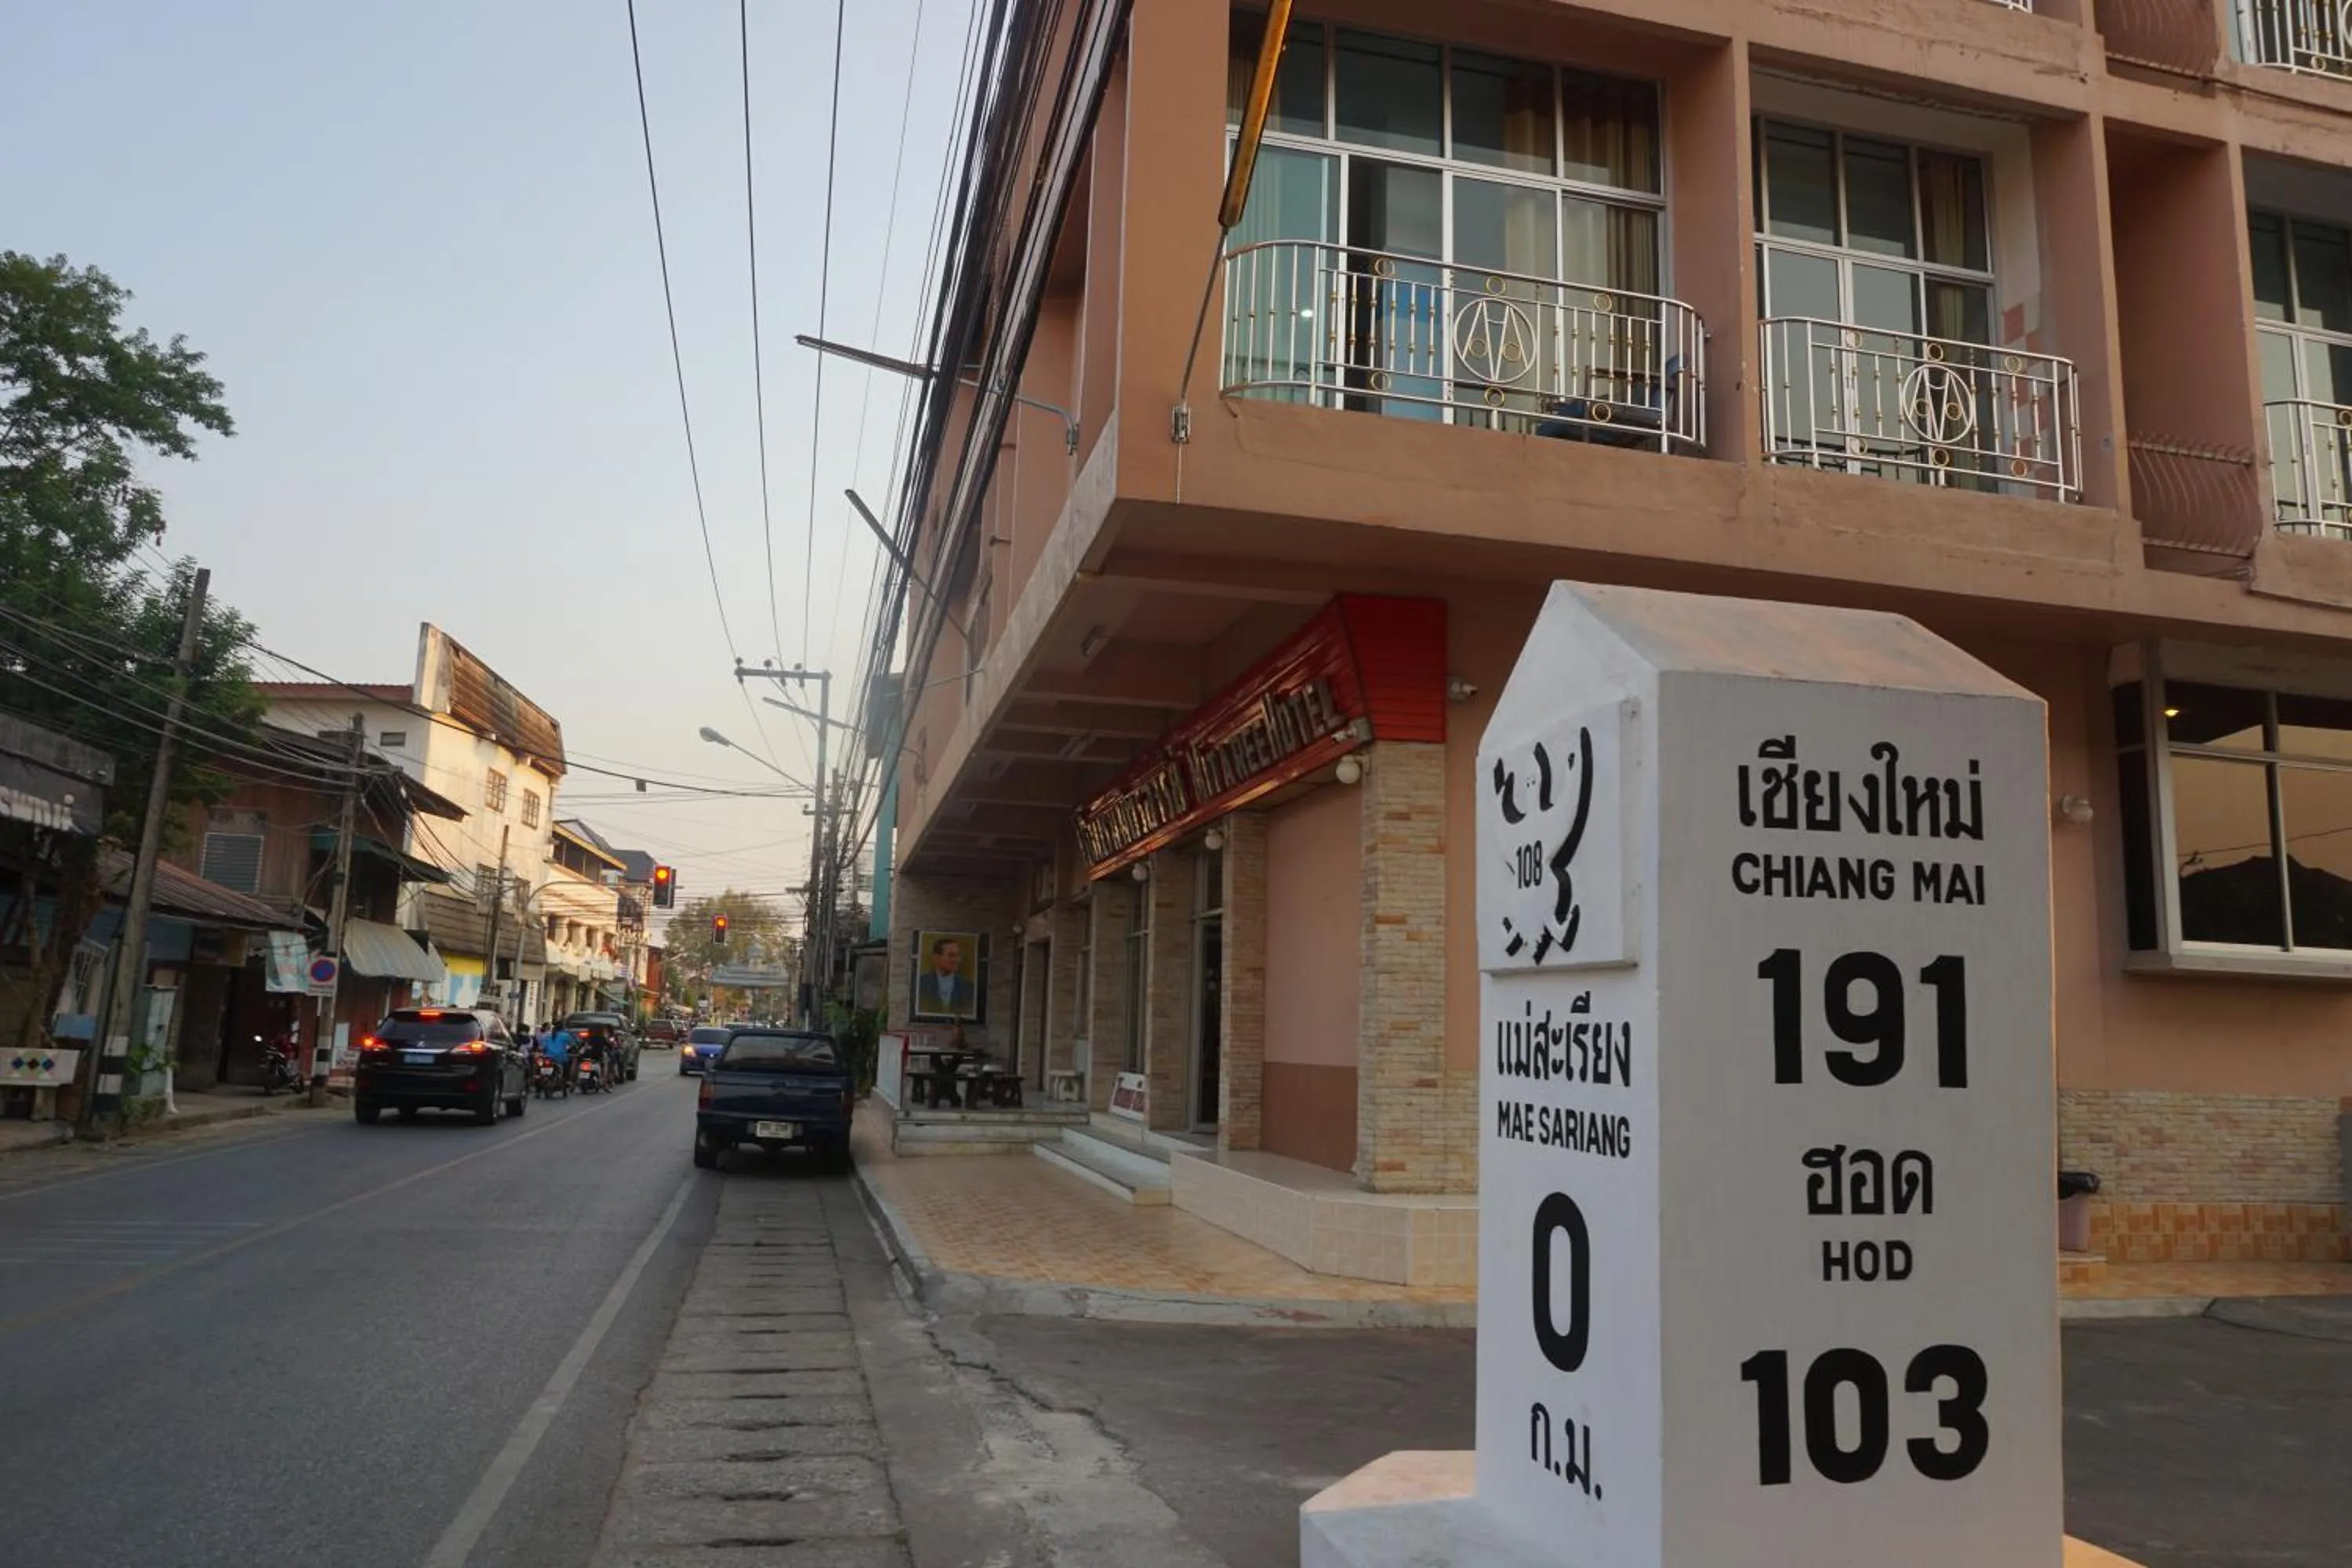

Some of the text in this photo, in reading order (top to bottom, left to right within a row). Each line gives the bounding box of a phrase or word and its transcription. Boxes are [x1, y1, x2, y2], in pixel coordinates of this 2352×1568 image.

[1261, 676, 1348, 761] HOTEL
[1738, 735, 1984, 841] เชียงใหม่
[1515, 840, 1543, 889] 108
[1732, 852, 1985, 906] CHIANG MAI
[1497, 990, 1631, 1087] แม่สะเรียง
[1758, 948, 1968, 1089] 191
[1497, 1100, 1631, 1159] MAE SARIANG
[1802, 1144, 1933, 1215] ฮอด
[1532, 1191, 1591, 1373] 0
[1822, 1240, 1913, 1282] HOD
[1530, 1402, 1602, 1501] ก.ม.
[1740, 1344, 1989, 1486] 103
